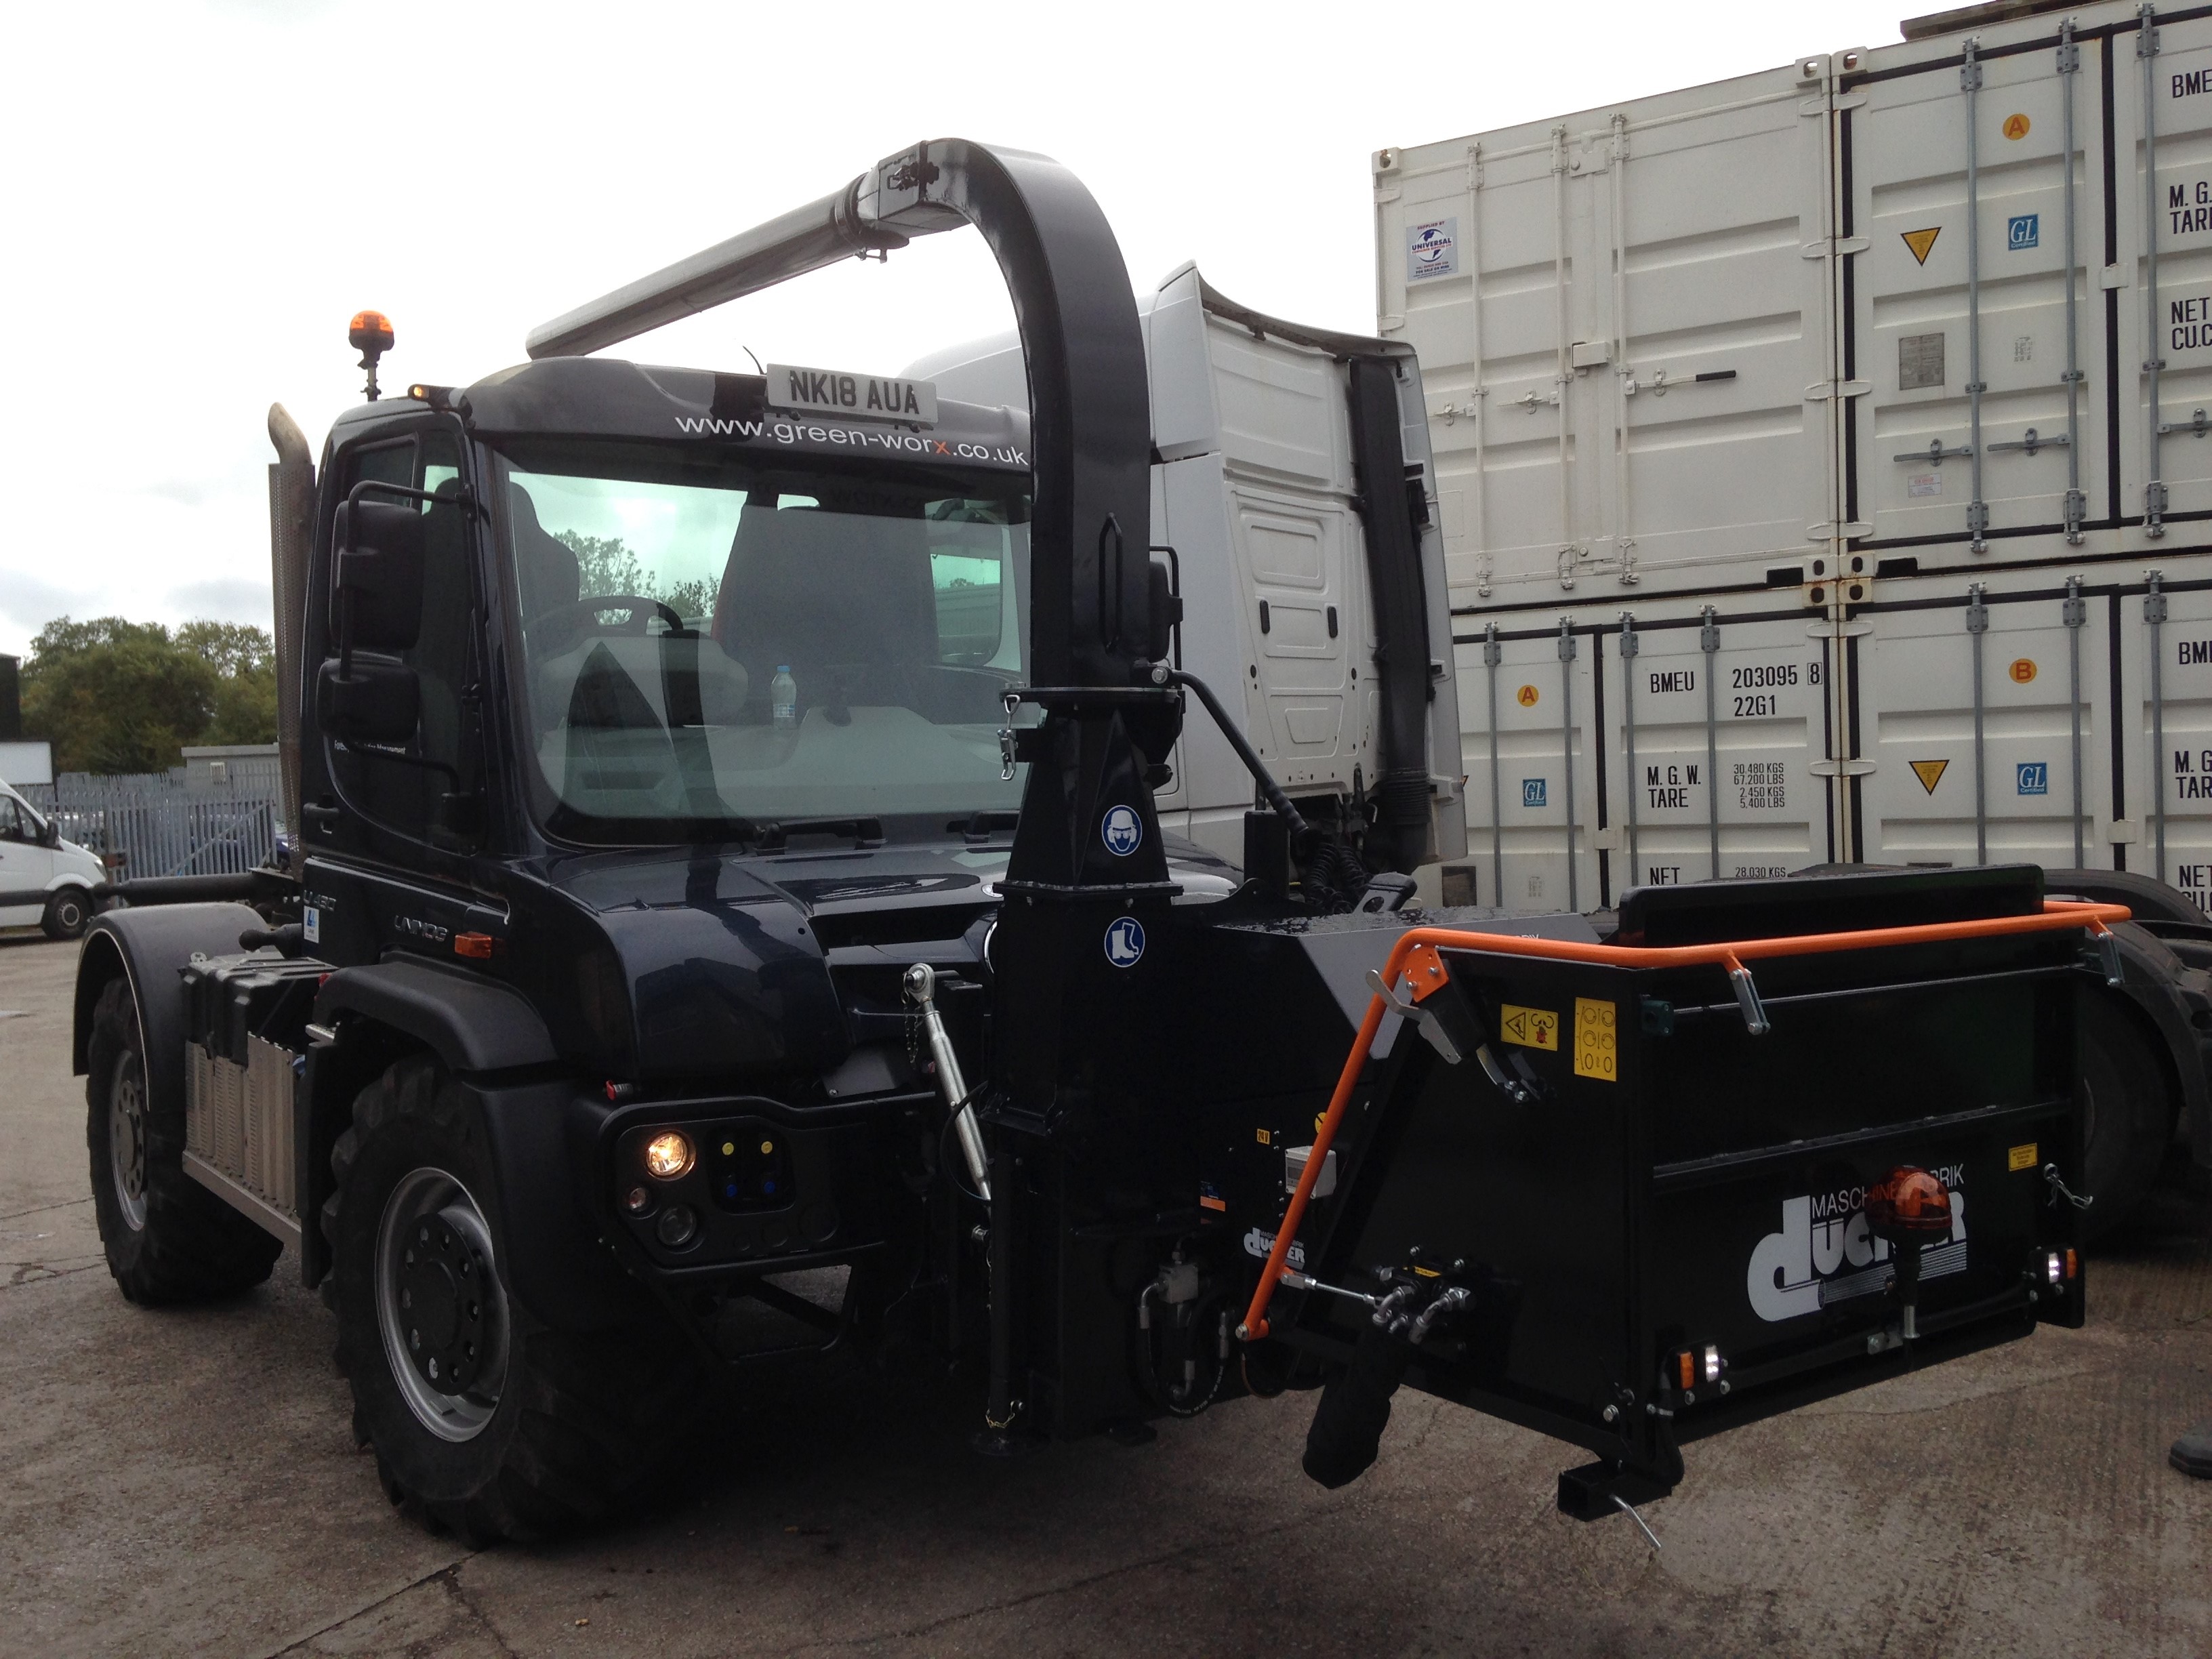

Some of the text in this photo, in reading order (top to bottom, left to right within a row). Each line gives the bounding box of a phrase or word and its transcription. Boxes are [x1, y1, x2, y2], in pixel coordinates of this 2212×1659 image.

[2008, 117, 2025, 137] A
[2170, 207, 2212, 234] TAR
[2010, 219, 2036, 243] GL
[1412, 238, 1452, 250] UNIVERSAL
[2171, 297, 2211, 324] NET
[790, 370, 920, 415] NK18 AUA
[674, 416, 1029, 466] www.green-worx.co.uk
[2179, 640, 2212, 665] BM
[1650, 663, 1820, 693] BMEU 203095 8
[2015, 662, 2032, 680] B
[1521, 687, 1535, 702] A
[1734, 695, 1776, 716] 22G1
[1767, 762, 1784, 773] KGS
[2019, 766, 2045, 788] GL
[1767, 773, 1784, 784] LBS
[1525, 781, 1545, 800] GL
[1648, 787, 1689, 808] TARE
[1767, 785, 1785, 797] KGS
[1767, 797, 1785, 808] LBS
[1769, 867, 1786, 878] KGS
